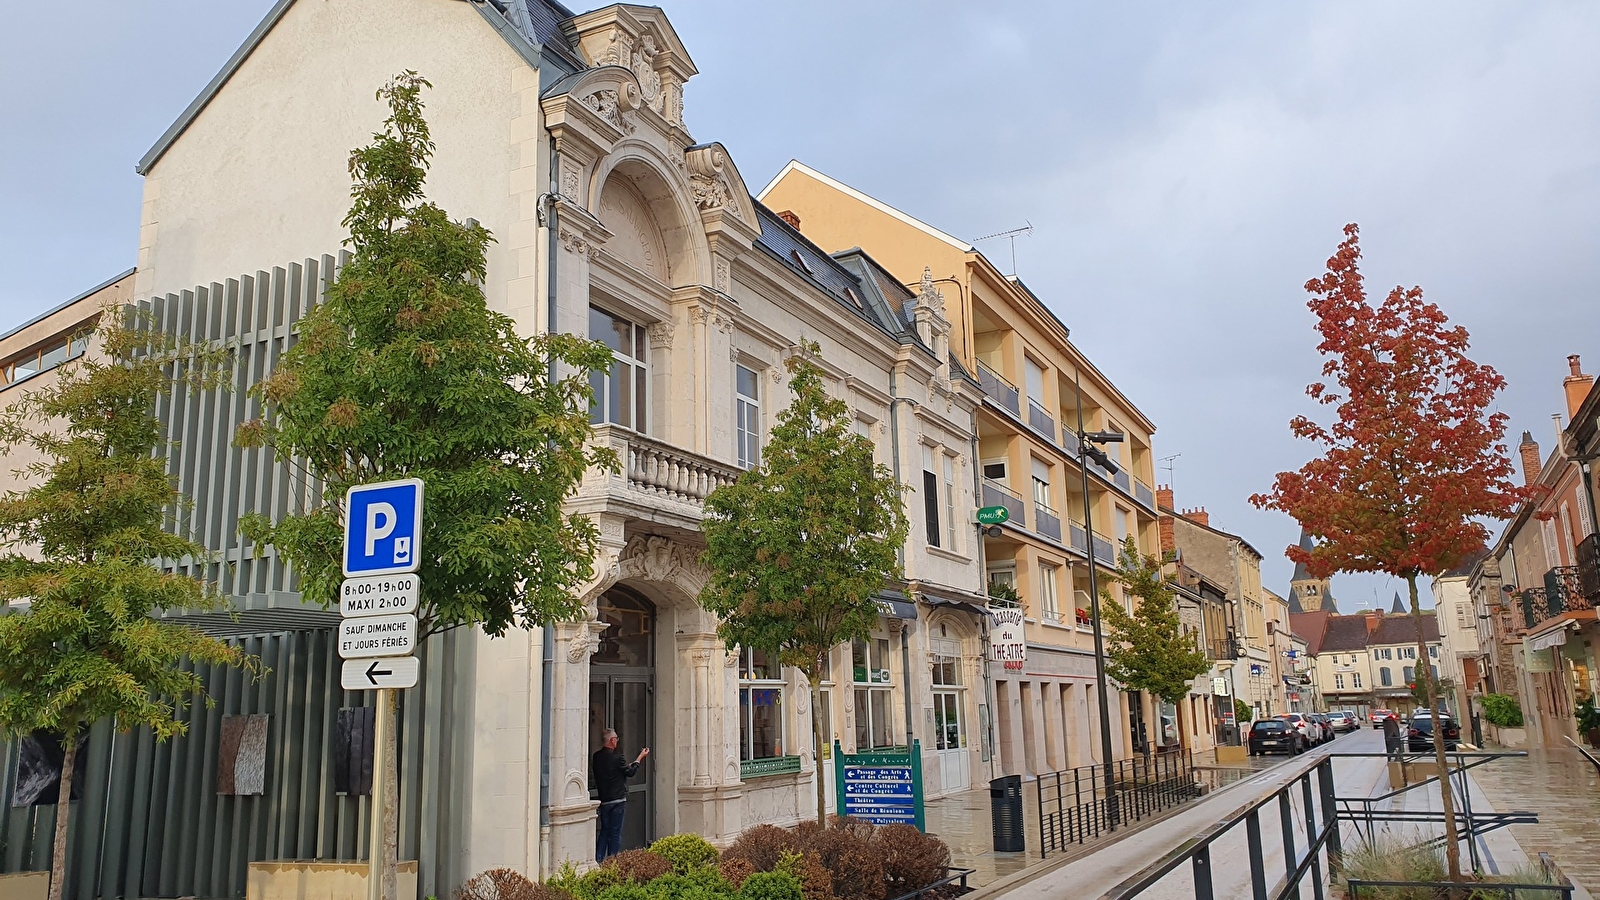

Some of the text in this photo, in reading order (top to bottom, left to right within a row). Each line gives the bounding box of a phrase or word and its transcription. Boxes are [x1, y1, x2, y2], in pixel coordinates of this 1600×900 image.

[979, 512, 995, 520] PMU
[364, 501, 398, 557] P
[348, 596, 407, 611] MAXI 2h00
[346, 622, 407, 635] SAUF DIMANCHE
[1002, 631, 1013, 640] du
[342, 636, 408, 650] ET JOURS FÉRIÉS
[992, 643, 1024, 660] THEATRE
